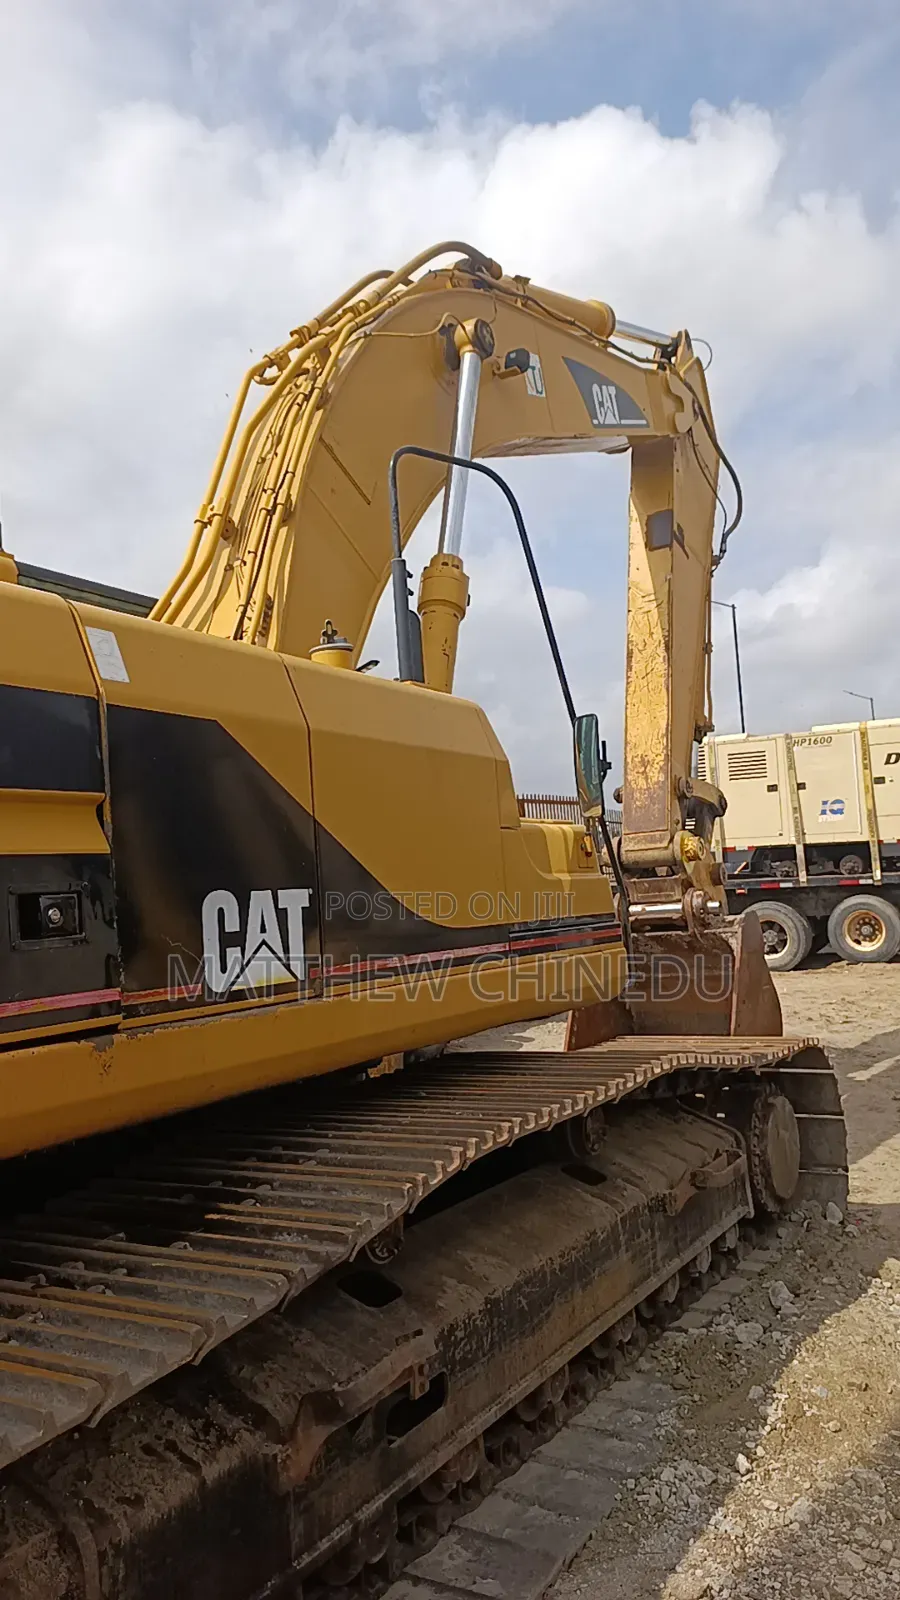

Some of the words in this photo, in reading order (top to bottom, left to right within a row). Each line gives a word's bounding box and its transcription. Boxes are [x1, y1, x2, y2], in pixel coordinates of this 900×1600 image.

[592, 383, 620, 424] CAT
[793, 736, 833, 747] HP1600
[202, 889, 310, 993] CAT
